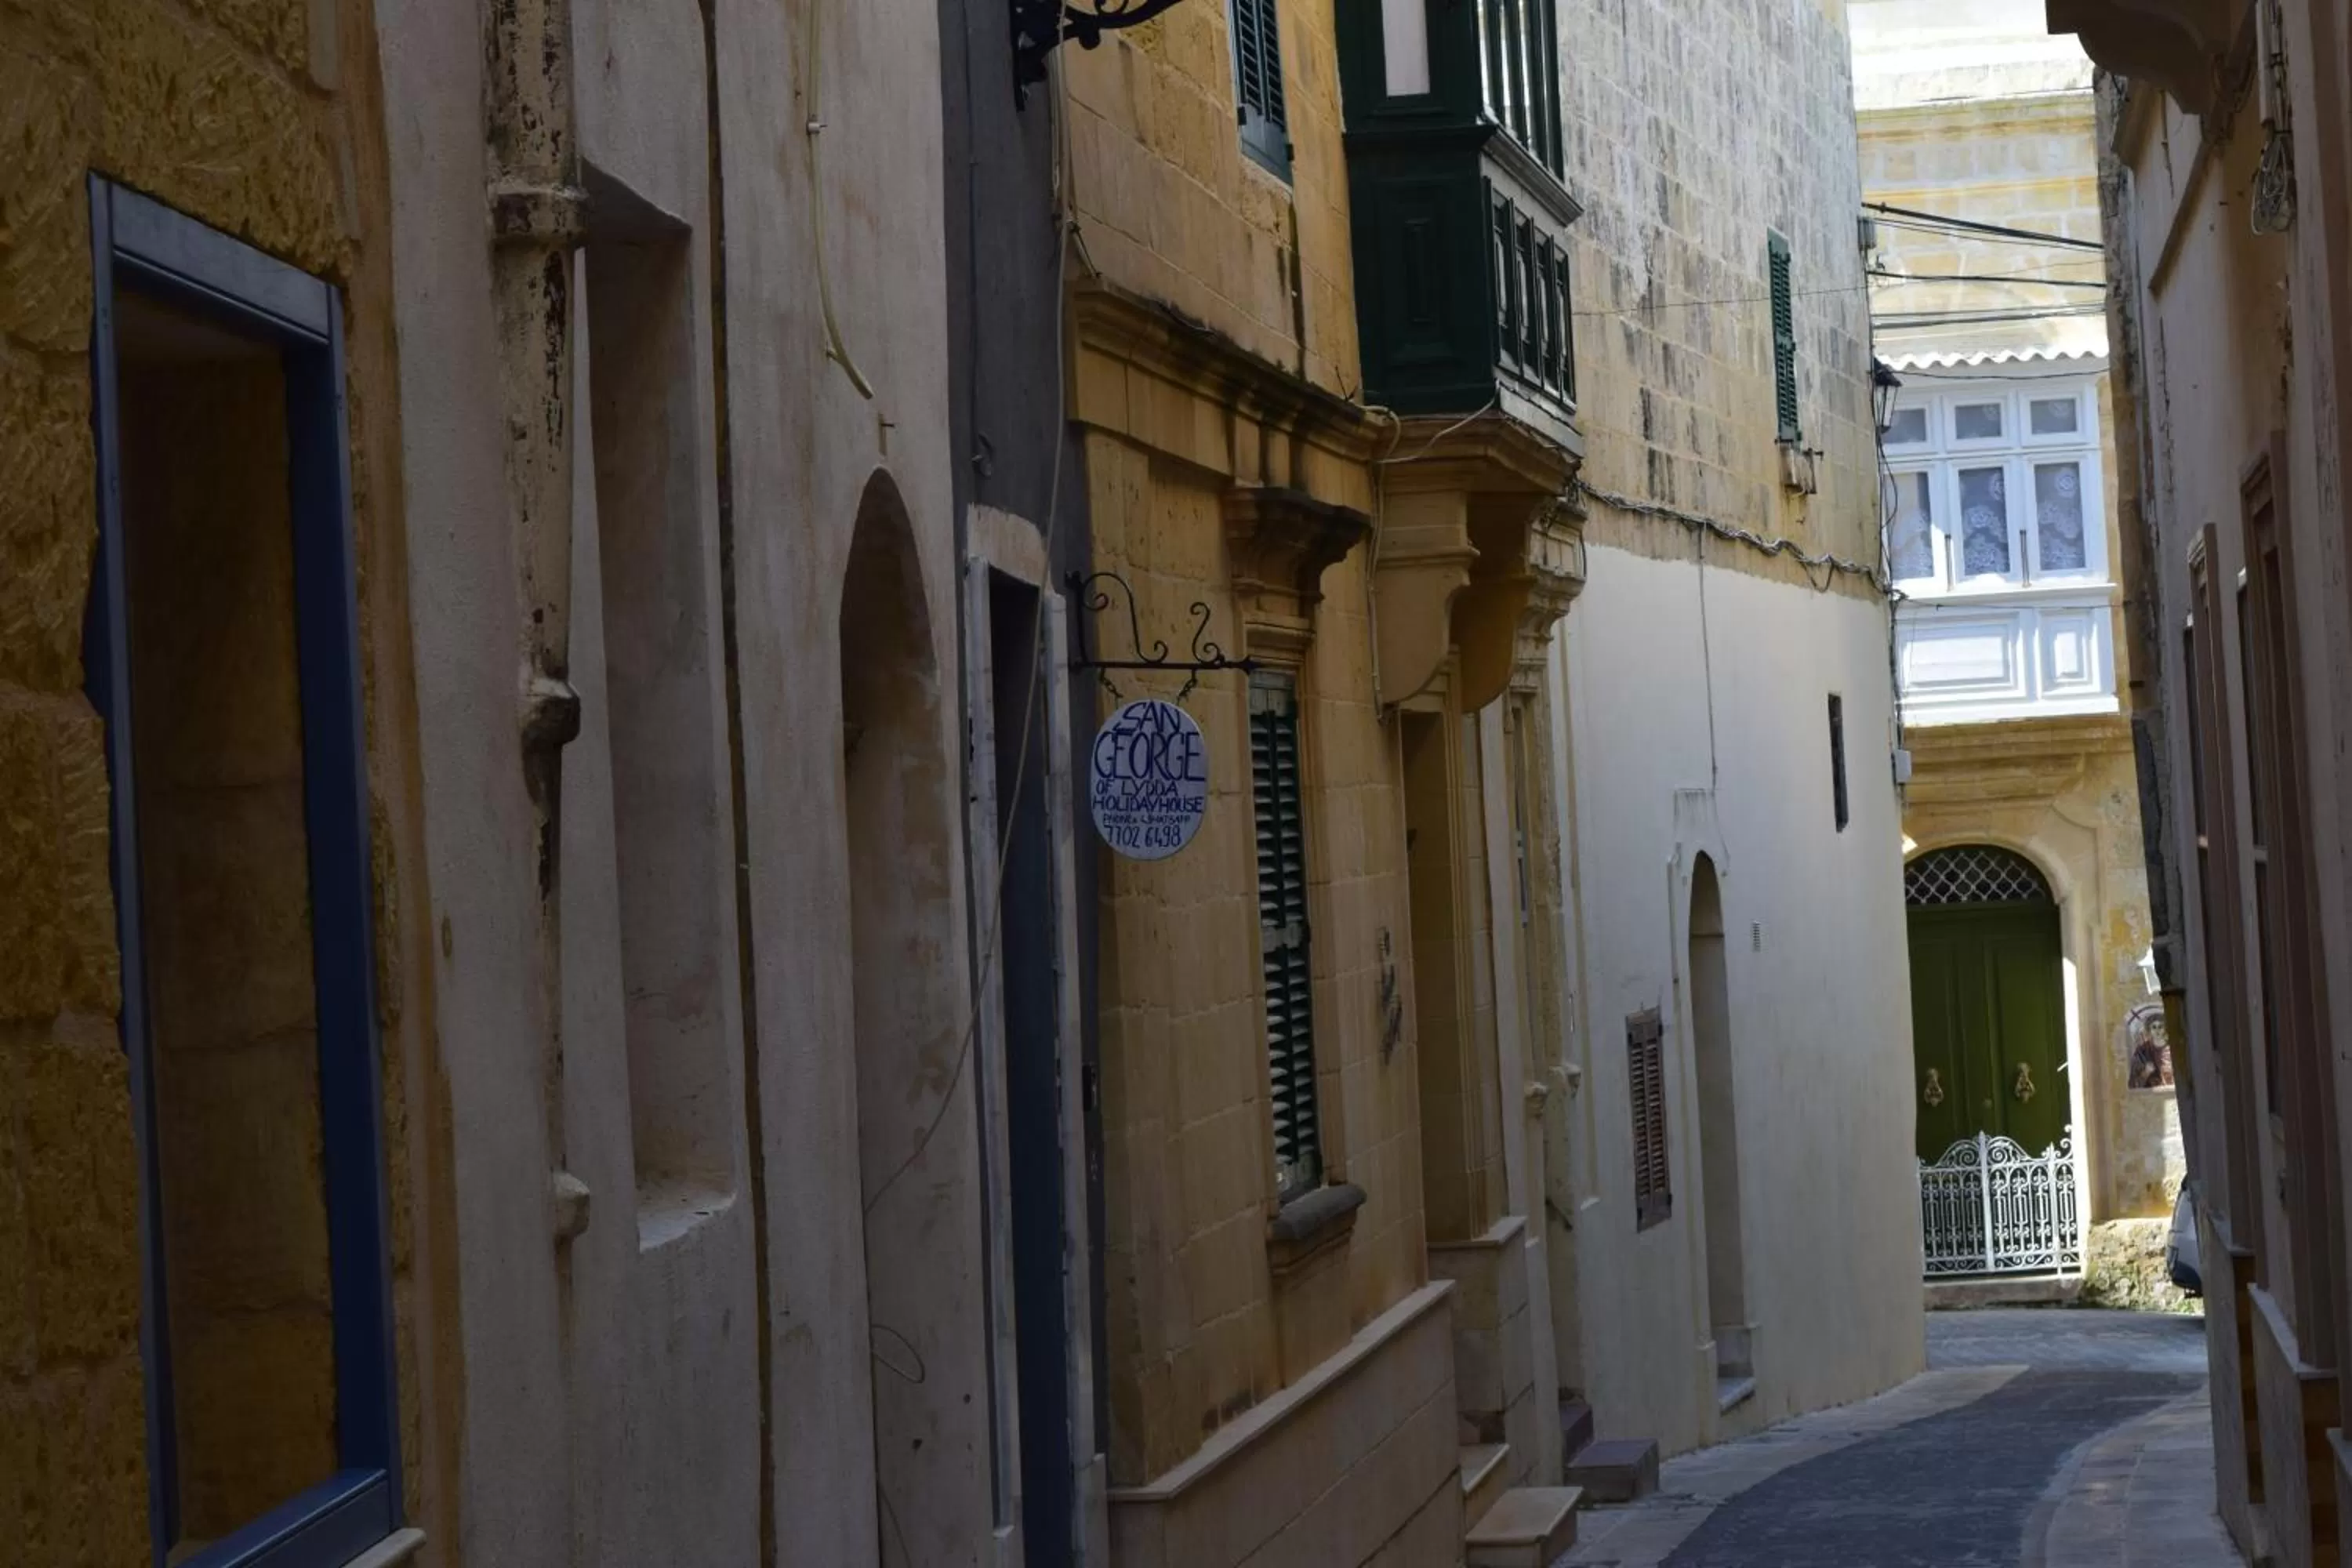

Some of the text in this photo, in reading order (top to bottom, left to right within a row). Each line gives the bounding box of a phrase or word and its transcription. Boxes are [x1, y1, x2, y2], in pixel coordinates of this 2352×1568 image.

[1112, 699, 1181, 731] SAN
[1094, 731, 1206, 781] GEORGE
[1095, 779, 1178, 798] OF LYDDA
[1104, 824, 1181, 848] 7702 6498
